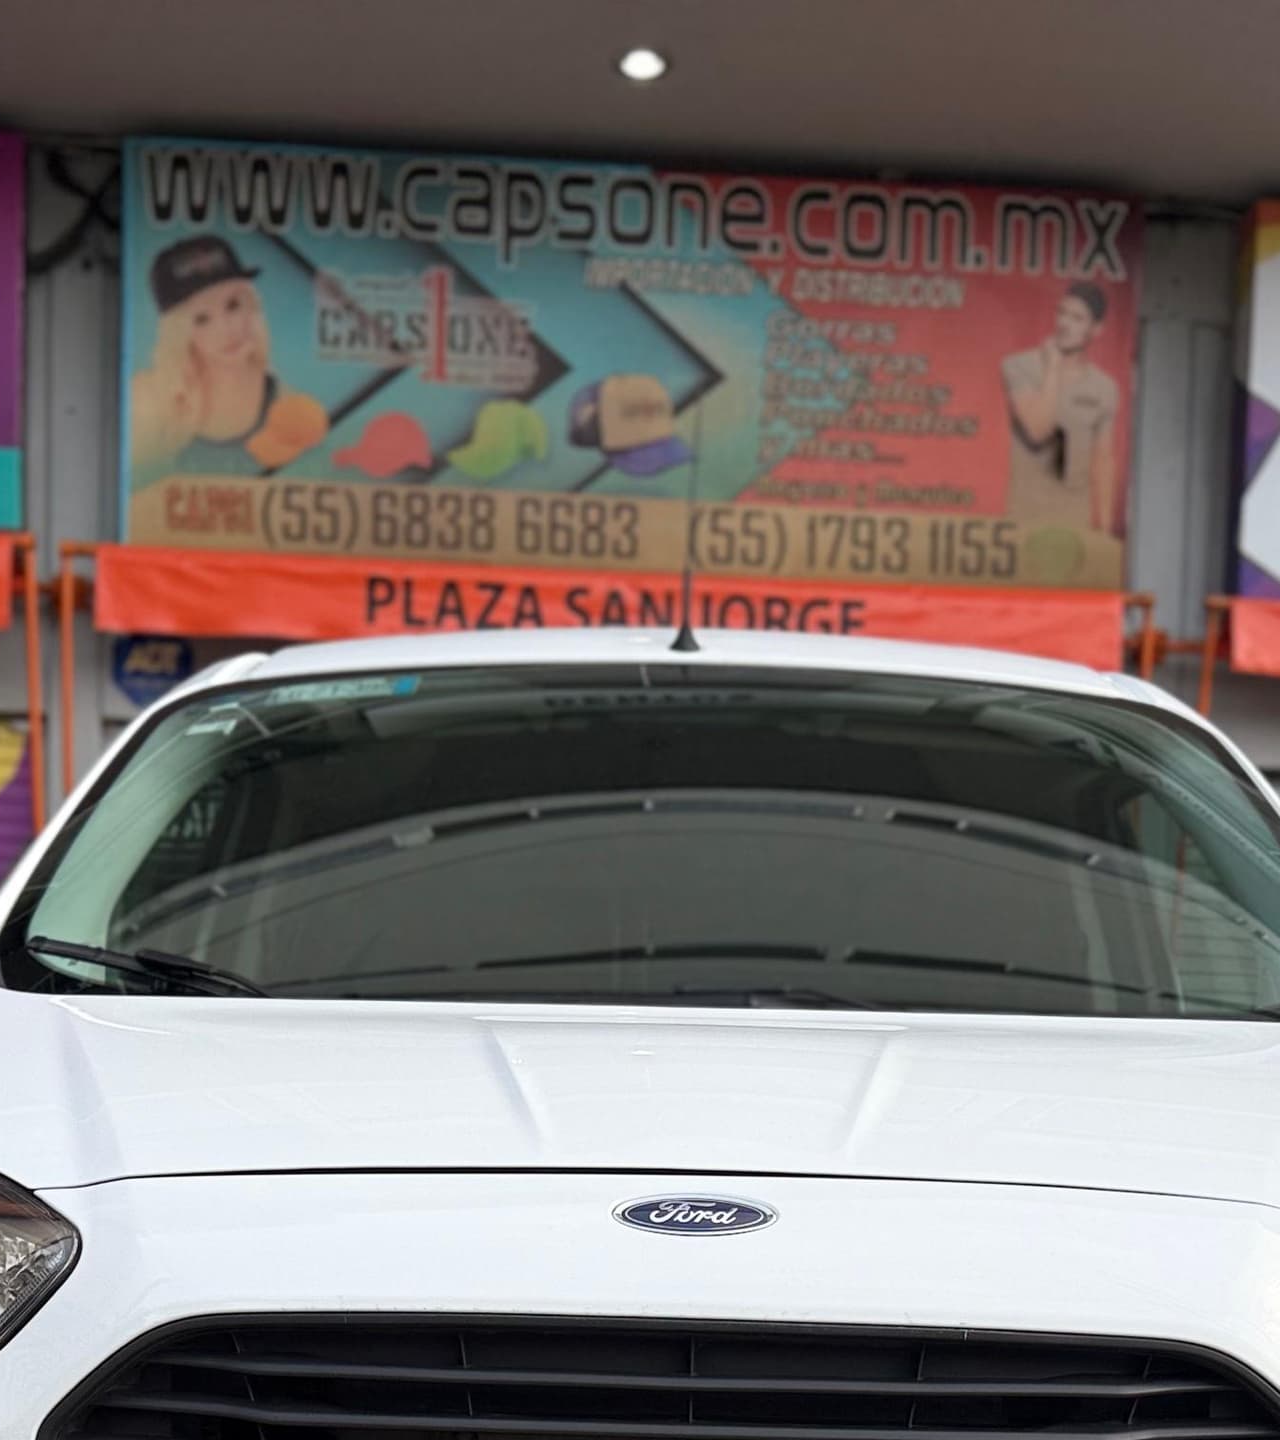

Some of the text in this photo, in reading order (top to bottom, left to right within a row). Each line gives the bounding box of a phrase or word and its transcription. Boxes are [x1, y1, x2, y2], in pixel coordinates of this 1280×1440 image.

[142, 148, 1128, 282] www.capsone.com.mx
[261, 485, 360, 550] (55)
[371, 489, 498, 553] 6838
[515, 498, 639, 561] 6683
[688, 508, 788, 572] (55)
[805, 514, 911, 576] 1793
[927, 520, 1019, 580] 1155
[366, 576, 545, 630] PLAZA
[566, 587, 675, 628] SAN
[649, 1201, 739, 1224] Ford
